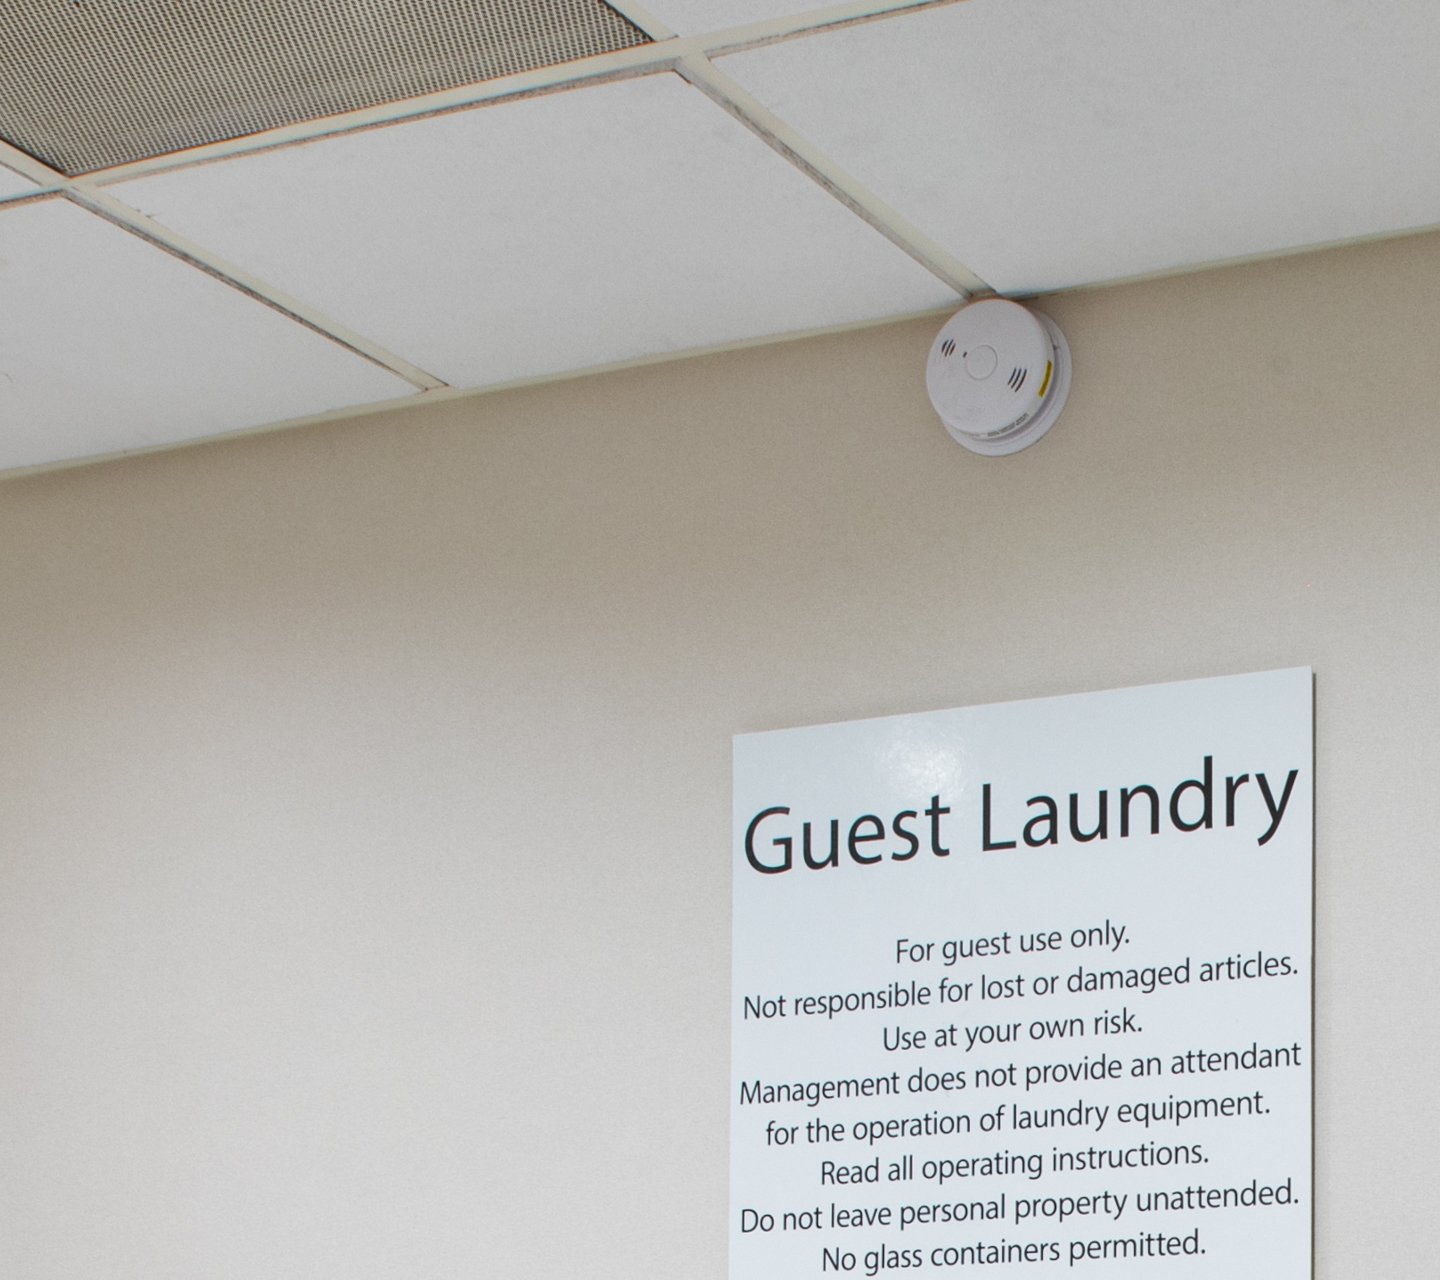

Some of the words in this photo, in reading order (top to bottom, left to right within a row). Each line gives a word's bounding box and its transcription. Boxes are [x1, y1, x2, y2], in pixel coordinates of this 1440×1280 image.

[744, 794, 950, 874] Guest
[982, 755, 1298, 851] Laundry
[896, 938, 935, 963] For
[942, 932, 1011, 966] guest
[1020, 931, 1062, 952] use
[1070, 919, 1129, 952] only.
[744, 995, 786, 1019] Not
[795, 980, 931, 1019] responsible
[938, 977, 973, 1003] for
[981, 974, 1024, 999] lost
[1033, 975, 1059, 995] or
[1067, 957, 1189, 993] damaged
[1199, 951, 1297, 982] articles.
[883, 1026, 926, 1051] Use
[934, 1024, 957, 1047] at
[965, 1023, 1021, 1052] your
[1029, 1018, 1084, 1040] own
[1094, 1007, 1142, 1035] risk.
[740, 1072, 899, 1107] Management
[907, 1066, 966, 1092] does
[975, 1063, 1016, 1087] not
[1026, 1053, 1122, 1091] provide
[1131, 1057, 1161, 1077] an
[1171, 1042, 1301, 1074] attendant
[766, 1120, 798, 1145] for
[805, 1117, 844, 1143] the
[852, 1110, 970, 1146] operation
[979, 1104, 1006, 1131] of
[1013, 1099, 1109, 1132] laundry
[1117, 1091, 1269, 1128] equipment.
[821, 1156, 879, 1185] Read
[888, 1154, 912, 1181] all
[922, 1150, 1042, 1185] operating
[1053, 1141, 1208, 1171] instructions.
[741, 1208, 774, 1233] Do
[783, 1207, 822, 1230] not
[831, 1202, 891, 1228] leave
[900, 1193, 1005, 1231] personal
[1015, 1190, 1127, 1225] property
[1137, 1177, 1298, 1211] unattended.
[823, 1247, 856, 1271] No
[864, 1243, 922, 1276] glass
[930, 1238, 1059, 1266] containers
[1070, 1227, 1205, 1267] permitted.
